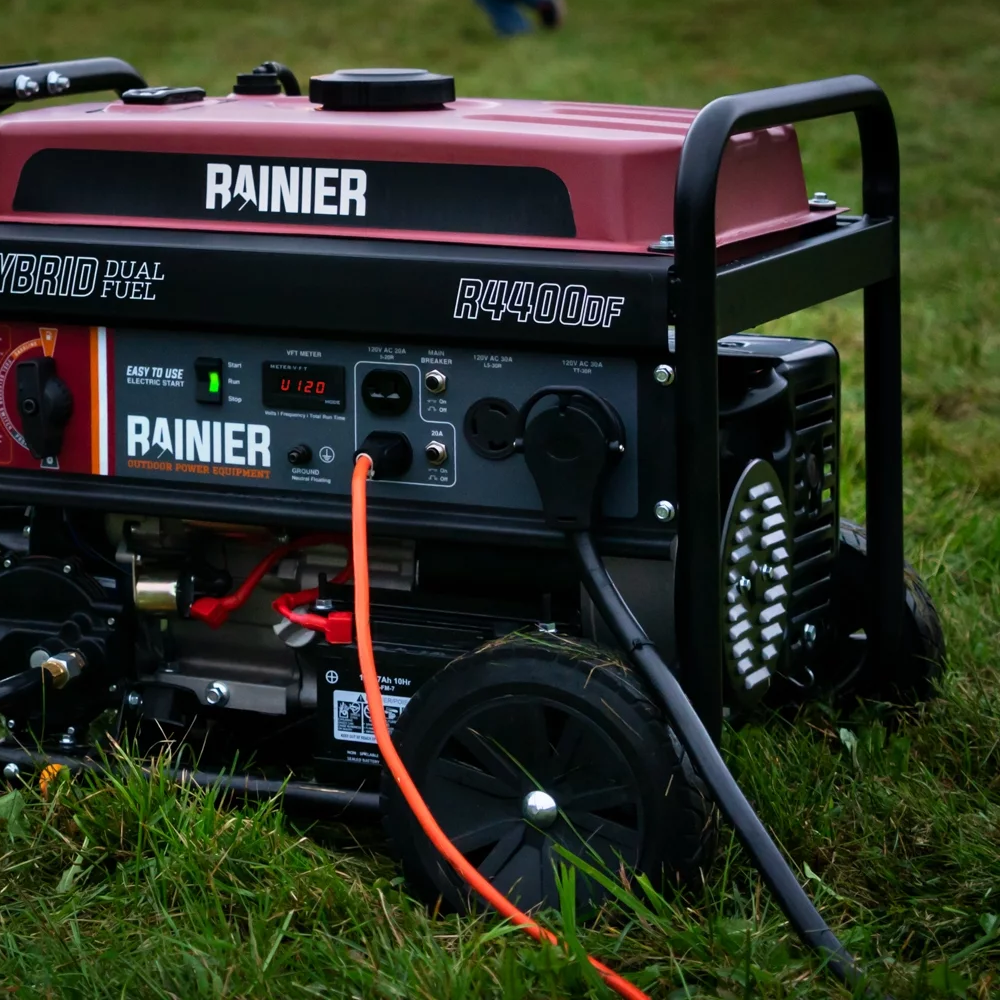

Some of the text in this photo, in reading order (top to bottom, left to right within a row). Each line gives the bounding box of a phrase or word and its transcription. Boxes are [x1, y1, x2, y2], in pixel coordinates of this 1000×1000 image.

[205, 163, 367, 216] RAINIER
[103, 260, 165, 281] DUAL
[100, 280, 156, 301] FUEL
[453, 277, 625, 328] R4400DF
[420, 357, 453, 365] BREAKER
[500, 355, 513, 363] 30A
[562, 359, 578, 367] 120V
[227, 361, 242, 369] Start
[126, 365, 184, 380] EASY TO USE
[126, 377, 185, 387] ELECTRIC START
[228, 395, 242, 403] Stop
[280, 411, 306, 419] Frequency
[127, 414, 271, 467] RAINIER
[127, 459, 271, 479] OUTDOOR POWER EQUIPMENT
[291, 467, 320, 475] GROUND
[393, 677, 412, 686] 10Hr
